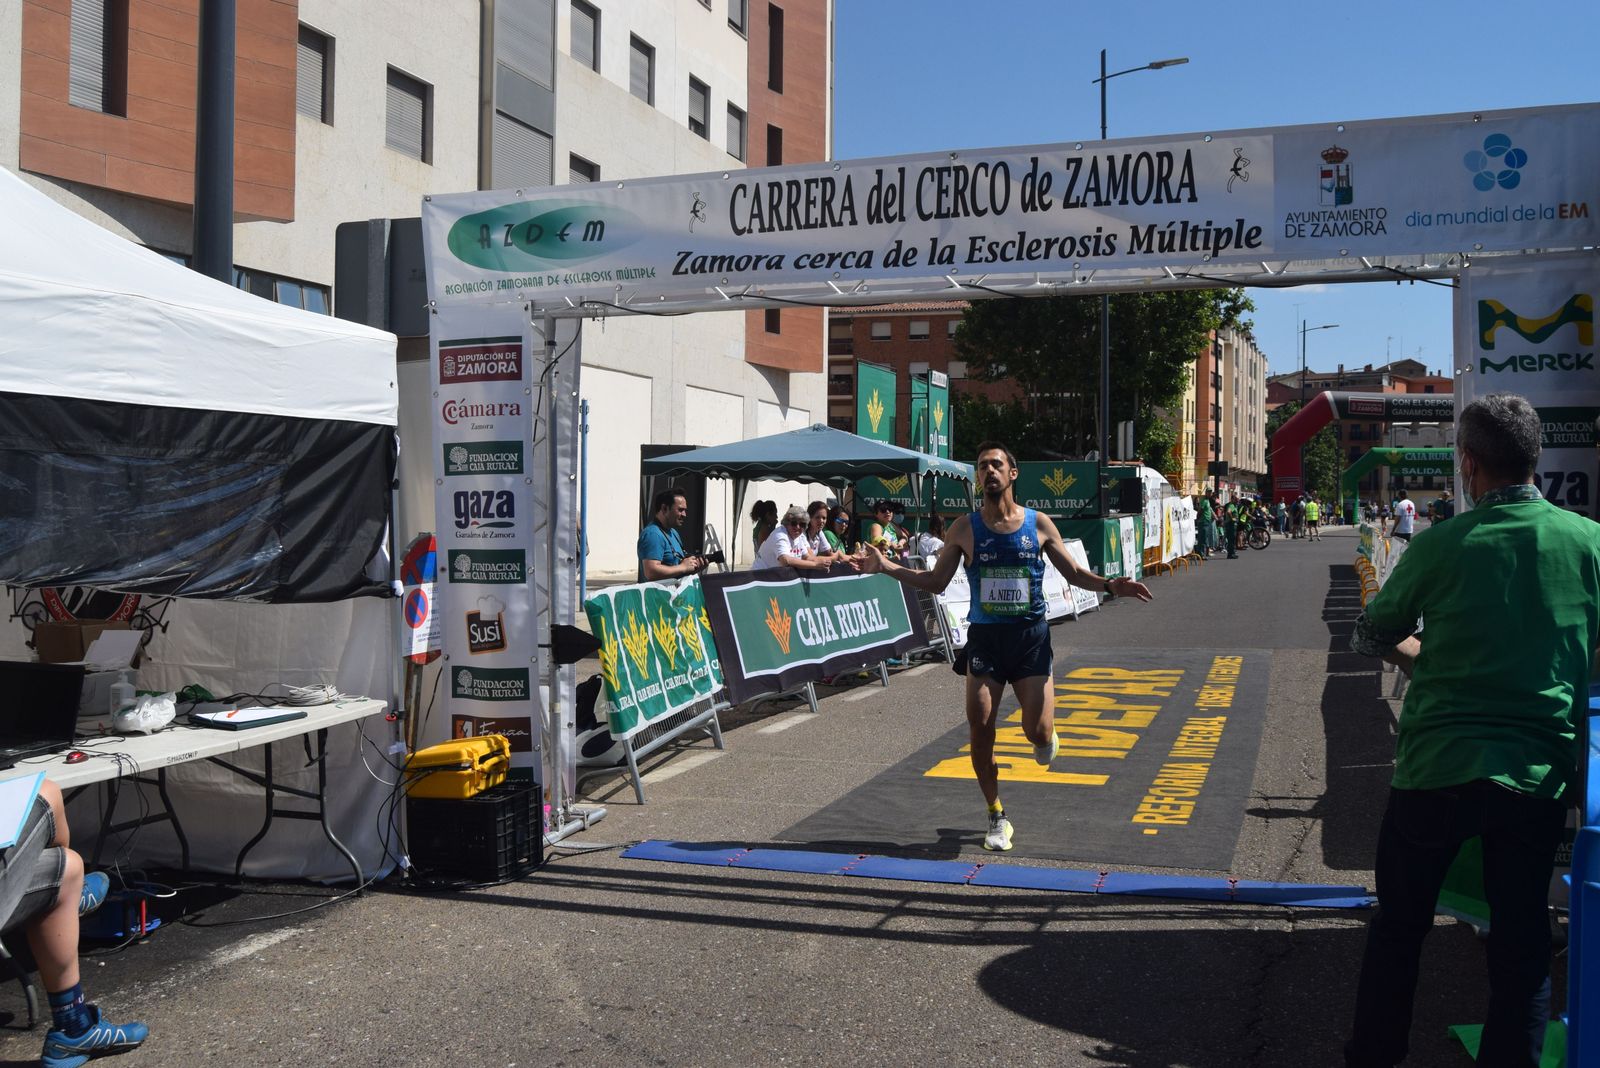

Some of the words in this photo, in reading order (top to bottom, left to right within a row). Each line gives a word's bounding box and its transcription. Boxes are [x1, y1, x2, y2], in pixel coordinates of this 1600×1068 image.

[730, 174, 857, 237] CARRERA
[867, 168, 906, 226] del
[916, 160, 1012, 222] CERCO
[1021, 156, 1053, 213] de
[1062, 149, 1199, 210] ZAMORA
[1285, 206, 1388, 224] AYUNTAMIENTO
[1435, 206, 1511, 226] mundial
[1513, 204, 1536, 221] de
[1539, 203, 1556, 219] la
[1557, 202, 1589, 219] EM
[1284, 222, 1307, 239] DE
[1310, 220, 1388, 238] ZAMORA
[672, 246, 784, 277] Zamora
[793, 246, 875, 271] cerca
[882, 239, 918, 268] de
[926, 237, 957, 266] la
[965, 228, 1118, 264] Esclerosis
[1127, 218, 1263, 258] Múltiple
[445, 279, 495, 296] ASOCIACIÓN
[497, 276, 545, 290] ZAMORANA
[548, 273, 561, 287] DE
[564, 270, 613, 285] ESCLEROSIS
[616, 267, 657, 282] MÚLTIPLE
[457, 353, 503, 362] DIPUTACIÓN
[505, 352, 517, 360] DE
[457, 361, 519, 376] ZAMORA
[1392, 399, 1411, 407] CON
[1412, 399, 1424, 408] EL
[1425, 399, 1454, 409] DEPOR
[1392, 409, 1432, 417] GANAMOS
[1434, 409, 1454, 418] TOD
[1553, 433, 1593, 443] RURAL
[469, 454, 518, 462] FUNDACION
[487, 463, 518, 471] RURAL
[1538, 471, 1589, 506] za
[454, 490, 515, 529] gaza
[943, 499, 968, 507] CAJA
[1026, 500, 1051, 509] CAJA
[1056, 500, 1093, 509] RURAL
[490, 531, 515, 539] Zamora
[472, 563, 521, 572] FUNDACION
[489, 572, 521, 580] RURAL
[989, 591, 997, 601] A.
[1000, 590, 1022, 601] NIETO
[796, 609, 837, 646] CAJA
[839, 599, 889, 638] RURAL
[470, 621, 501, 644] Susi
[473, 680, 524, 688] FUNDACION
[491, 688, 524, 696] RURAL
[923, 667, 1185, 786] PIDEPAR
[1168, 716, 1228, 758] INTEGRAL
[166, 751, 199, 764] SMARTCHIP
[1131, 763, 1212, 825] REFORMA
